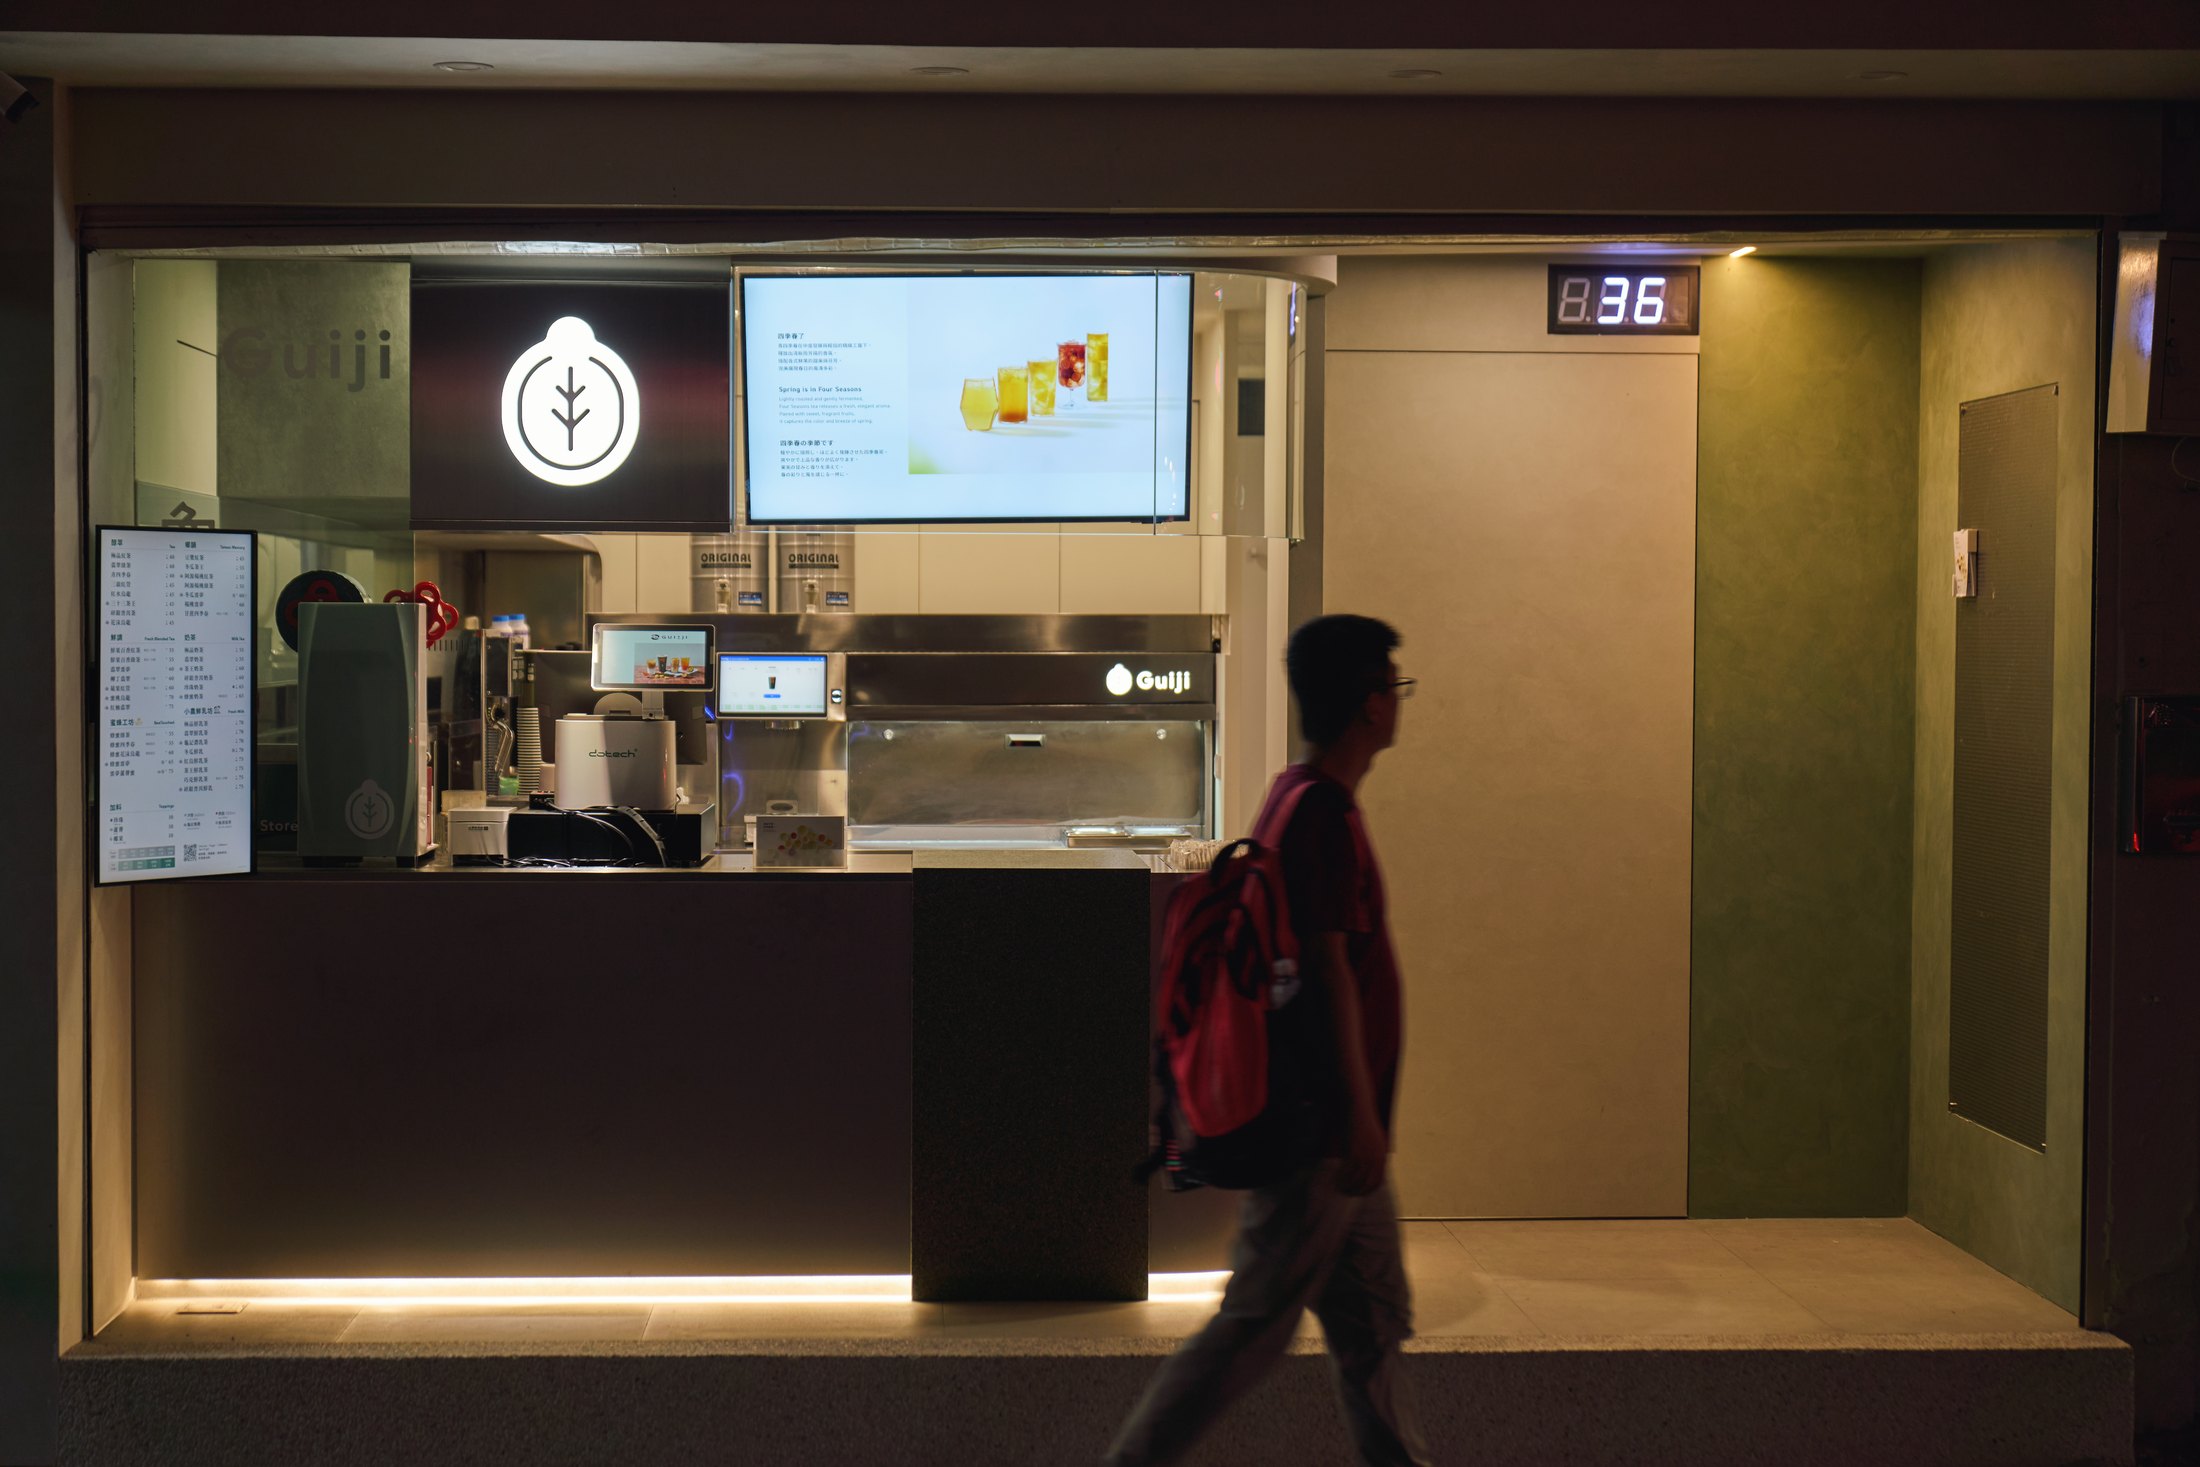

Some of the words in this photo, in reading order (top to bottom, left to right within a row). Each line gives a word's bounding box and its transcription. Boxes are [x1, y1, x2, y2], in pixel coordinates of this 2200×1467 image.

[1598, 277, 1666, 324] 36
[222, 327, 391, 392] Guiji
[701, 553, 751, 562] ORIGINAL
[789, 553, 839, 563] ORIGINAL
[1136, 670, 1190, 694] Guiji
[588, 749, 636, 758] dotech
[260, 819, 299, 832] Store
